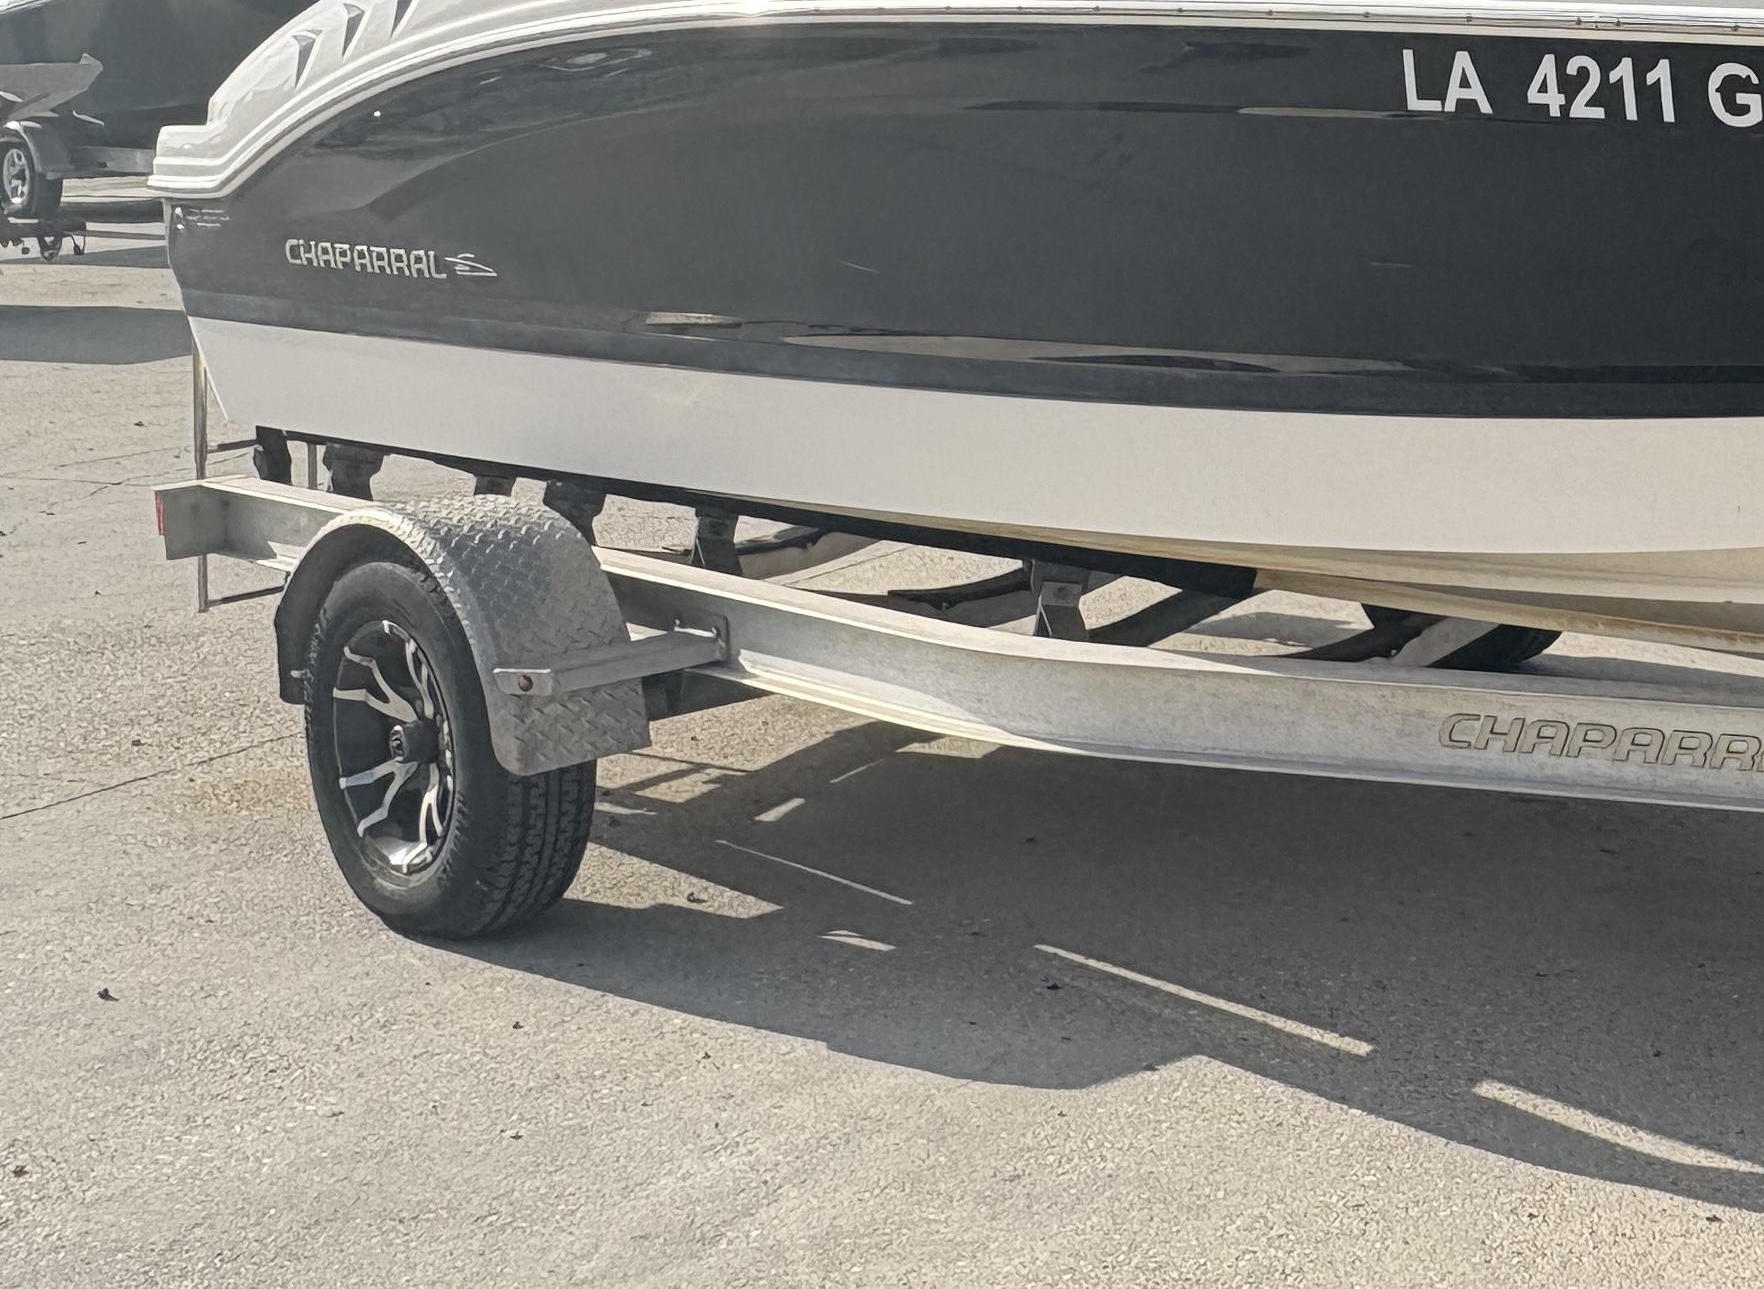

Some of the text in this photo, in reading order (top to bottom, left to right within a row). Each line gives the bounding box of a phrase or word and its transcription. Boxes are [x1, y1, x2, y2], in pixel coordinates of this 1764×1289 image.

[1402, 48, 1493, 115] LA
[1526, 53, 1676, 123] 4211
[284, 238, 448, 280] CHAPARRAL
